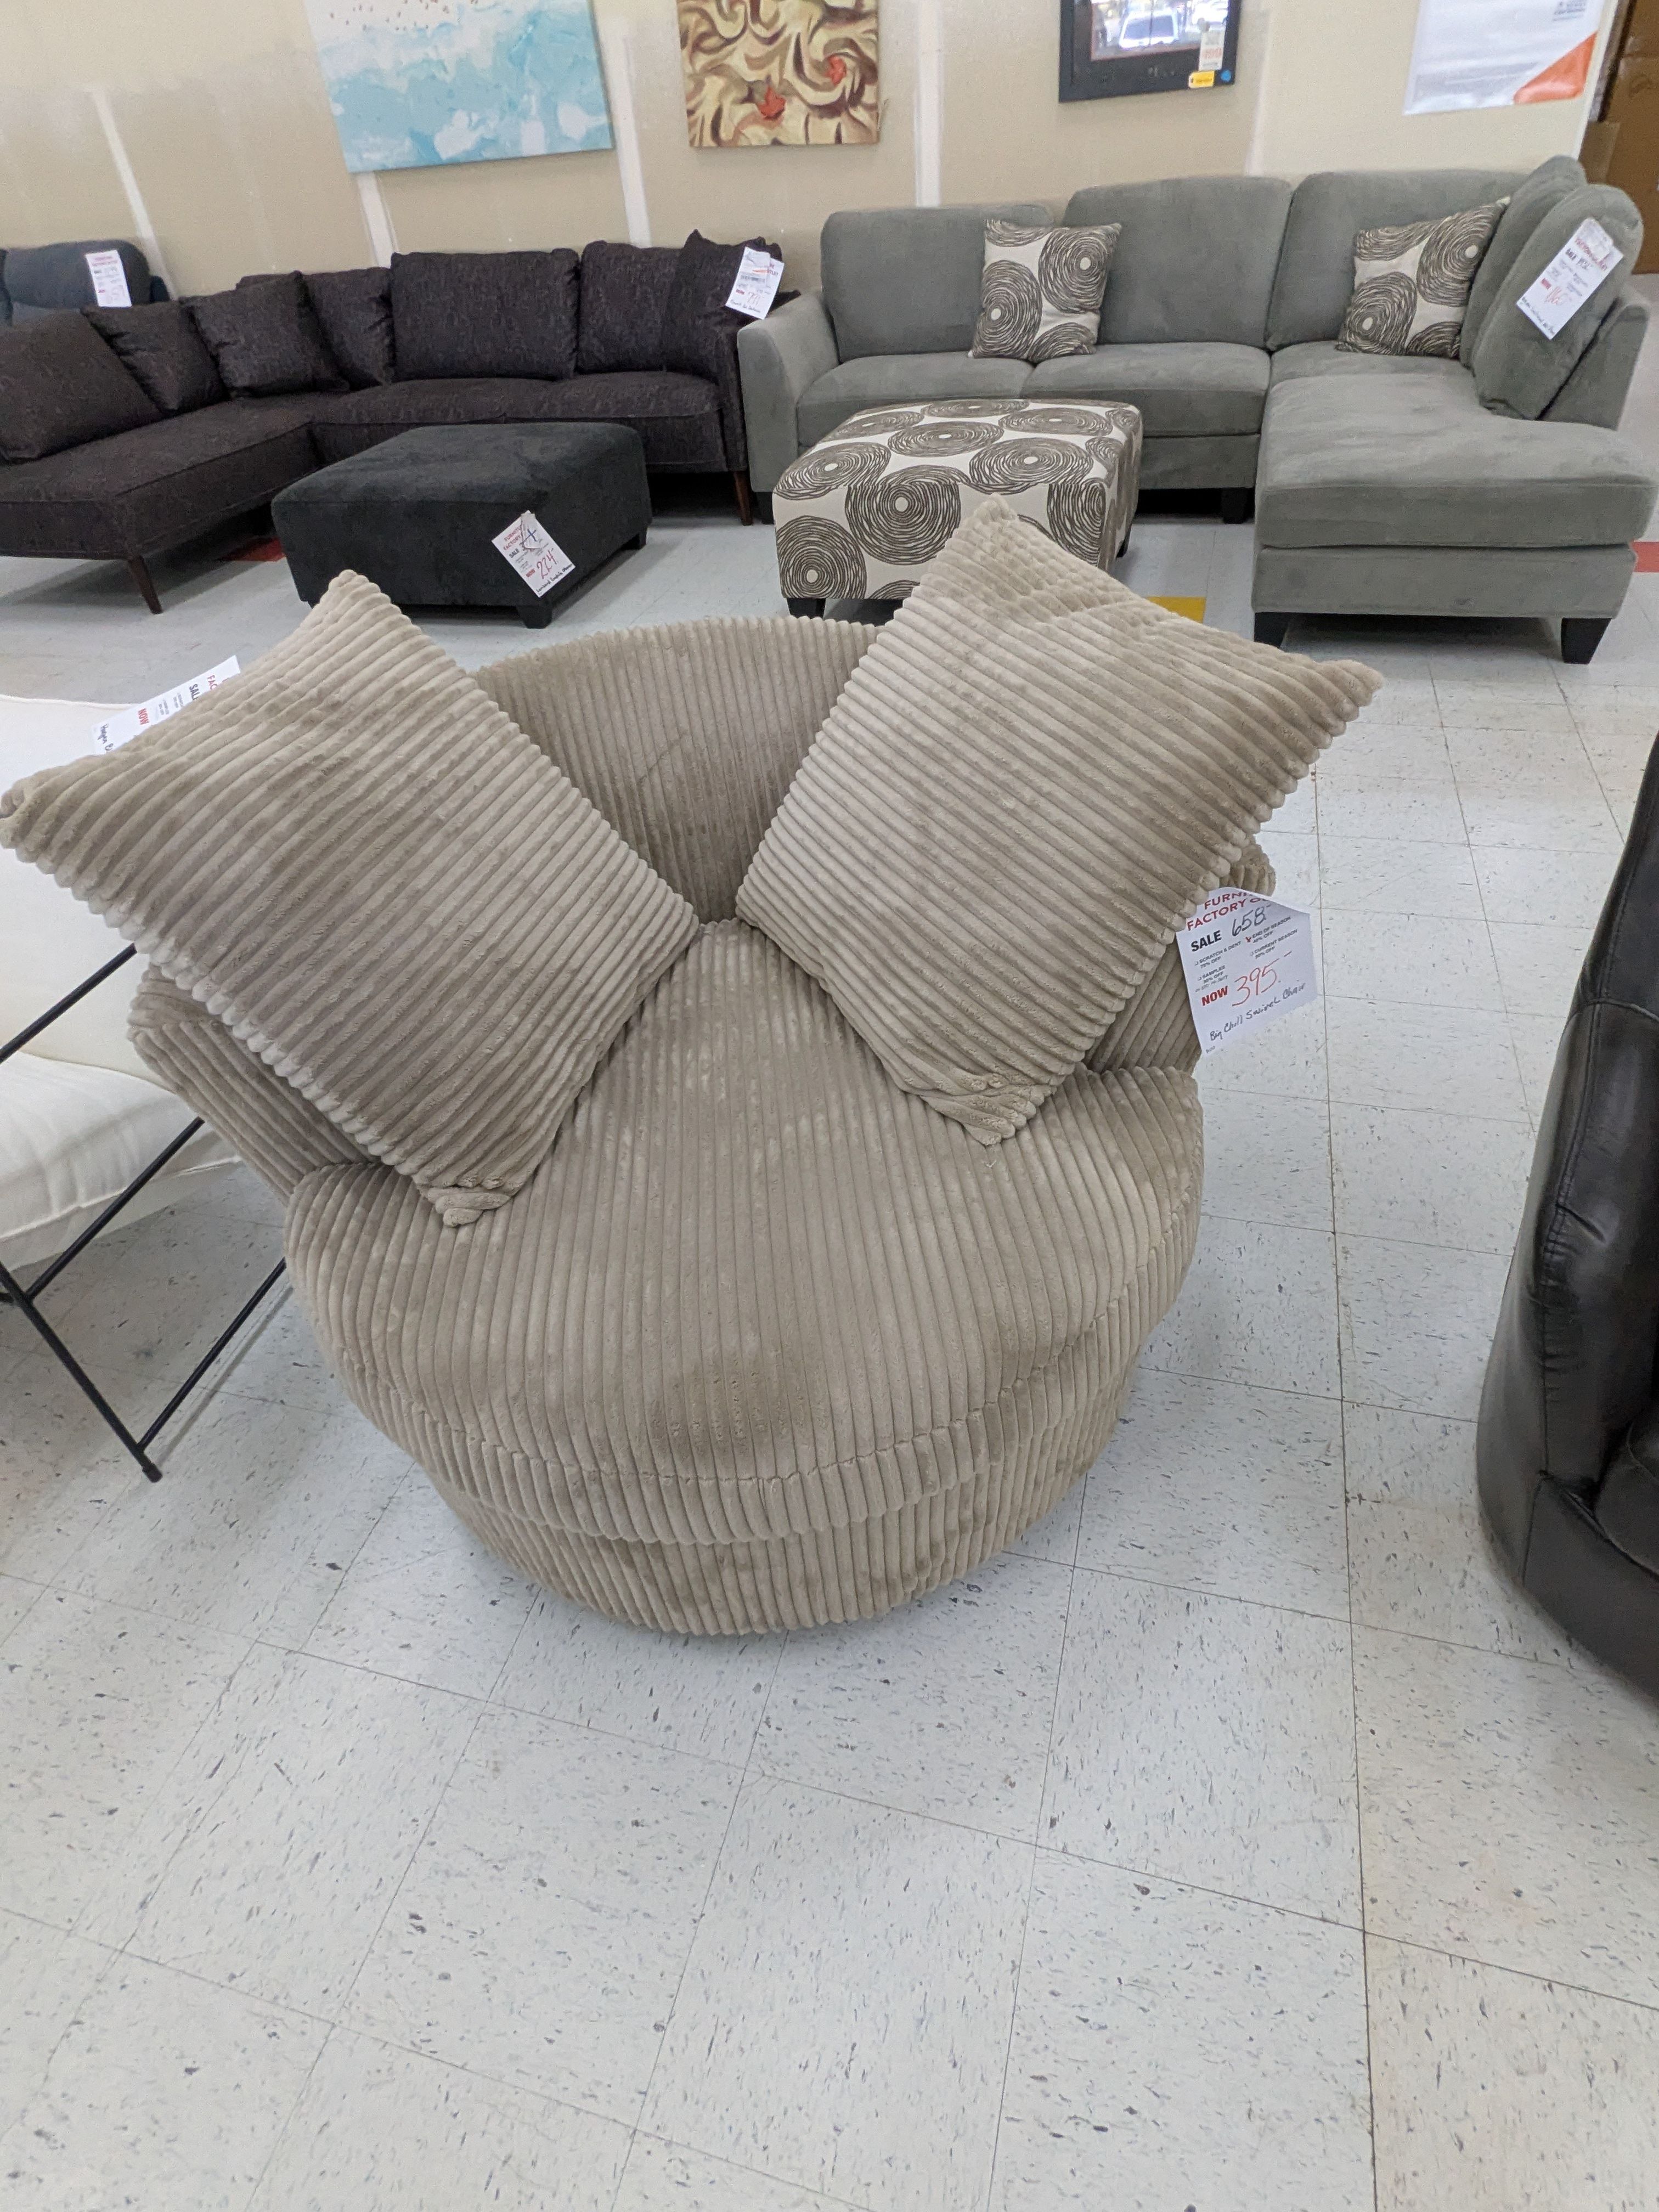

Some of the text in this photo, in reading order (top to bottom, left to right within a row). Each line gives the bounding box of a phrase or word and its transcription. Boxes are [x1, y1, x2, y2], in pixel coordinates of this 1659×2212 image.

[138, 708, 150, 725] NOW
[1187, 898, 1247, 931] FACTORY
[1270, 916, 1291, 929] SEASON
[1190, 930, 1222, 952] SALE
[1254, 929, 1297, 953] CURRENT SEASON
[1199, 950, 1223, 964] SCRATCH
[1228, 941, 1241, 950] DENT
[1202, 965, 1226, 979] SAMPLES
[1201, 985, 1228, 1006] NOW
[1210, 1030, 1223, 1041] Big
[1224, 1015, 1243, 1032] Chill
